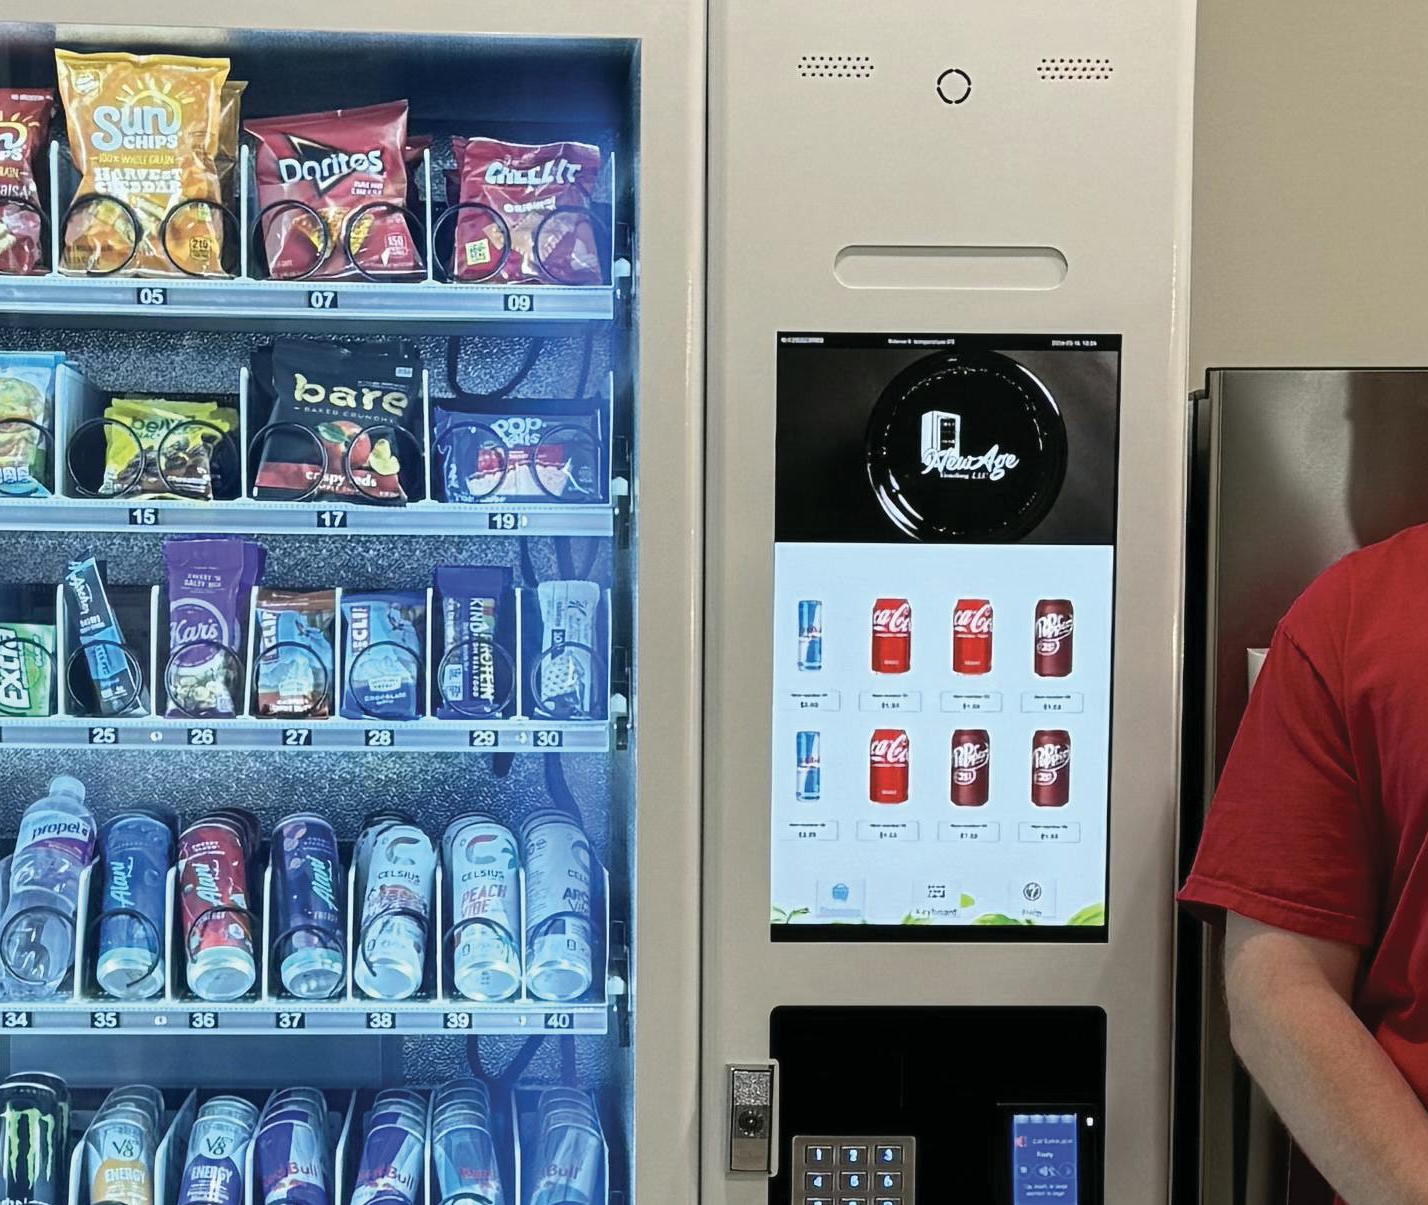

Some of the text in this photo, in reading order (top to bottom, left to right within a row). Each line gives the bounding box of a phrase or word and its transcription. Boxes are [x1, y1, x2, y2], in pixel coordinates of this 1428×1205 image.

[123, 134, 178, 149] CHIPS
[278, 150, 385, 184] Doritos
[139, 289, 163, 305] 05
[310, 291, 334, 308] 07
[507, 294, 531, 311] 09
[294, 373, 409, 417] bare
[305, 471, 378, 488] crspy eds
[132, 508, 156, 525] 15
[322, 510, 345, 528] 17
[491, 513, 515, 530] 19
[469, 598, 486, 634] KIND
[92, 728, 117, 743] 25
[190, 728, 214, 745] 26
[285, 729, 309, 745] 27
[368, 731, 392, 747] 28
[471, 731, 496, 747] 29
[536, 731, 560, 747] 30
[32, 822, 81, 841] propel
[377, 869, 421, 885] CELSIUS
[461, 869, 504, 882] CELSIUS
[461, 883, 508, 904] PEACH
[5, 1011, 28, 1028] 34
[93, 1012, 117, 1029] 35
[192, 1012, 215, 1029] 36
[278, 1012, 302, 1029] 37
[369, 1012, 393, 1029] 38
[446, 1012, 470, 1029] 39
[547, 1012, 570, 1029] 40
[206, 1135, 228, 1157] V8
[816, 1148, 823, 1161] 1
[883, 1148, 893, 1161] 3
[849, 1149, 858, 1162] 2
[104, 1166, 146, 1184] ENERGY
[190, 1165, 234, 1184] ENERGY
[288, 1161, 319, 1177] Bull
[388, 1164, 414, 1189] Bull
[813, 1176, 823, 1188] 4
[883, 1175, 893, 1188] 6
